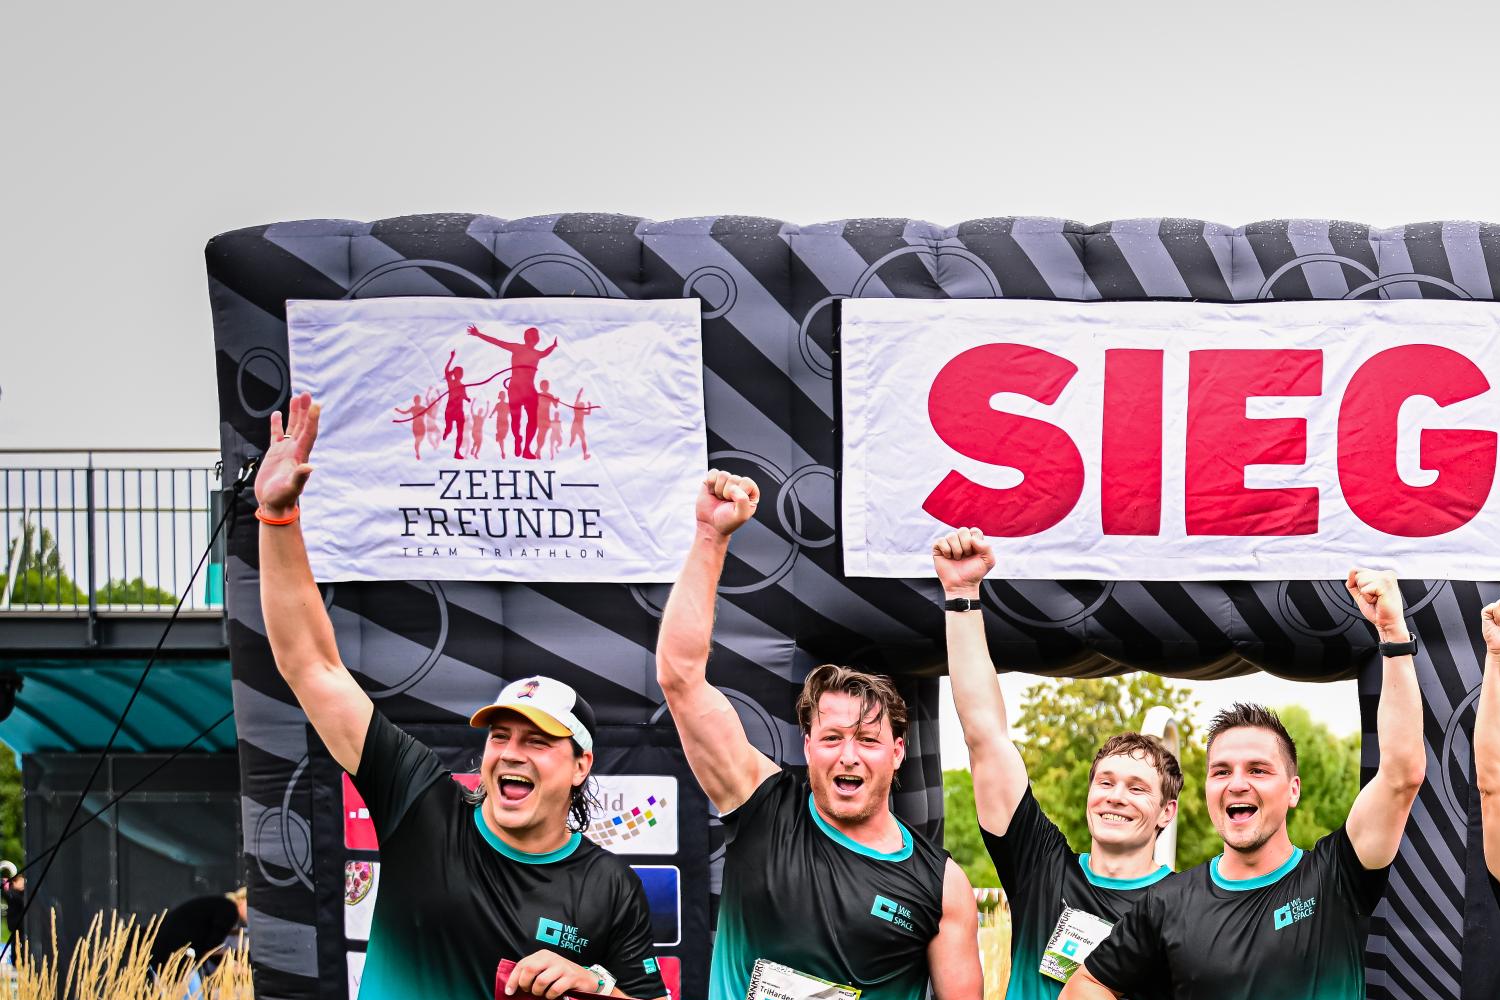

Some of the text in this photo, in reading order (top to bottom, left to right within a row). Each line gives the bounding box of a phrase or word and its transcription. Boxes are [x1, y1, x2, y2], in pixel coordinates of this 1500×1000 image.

[438, 469, 556, 501] ZEHN
[399, 507, 604, 539] FREUNDE
[402, 546, 605, 559] TEAM TRIATHLON
